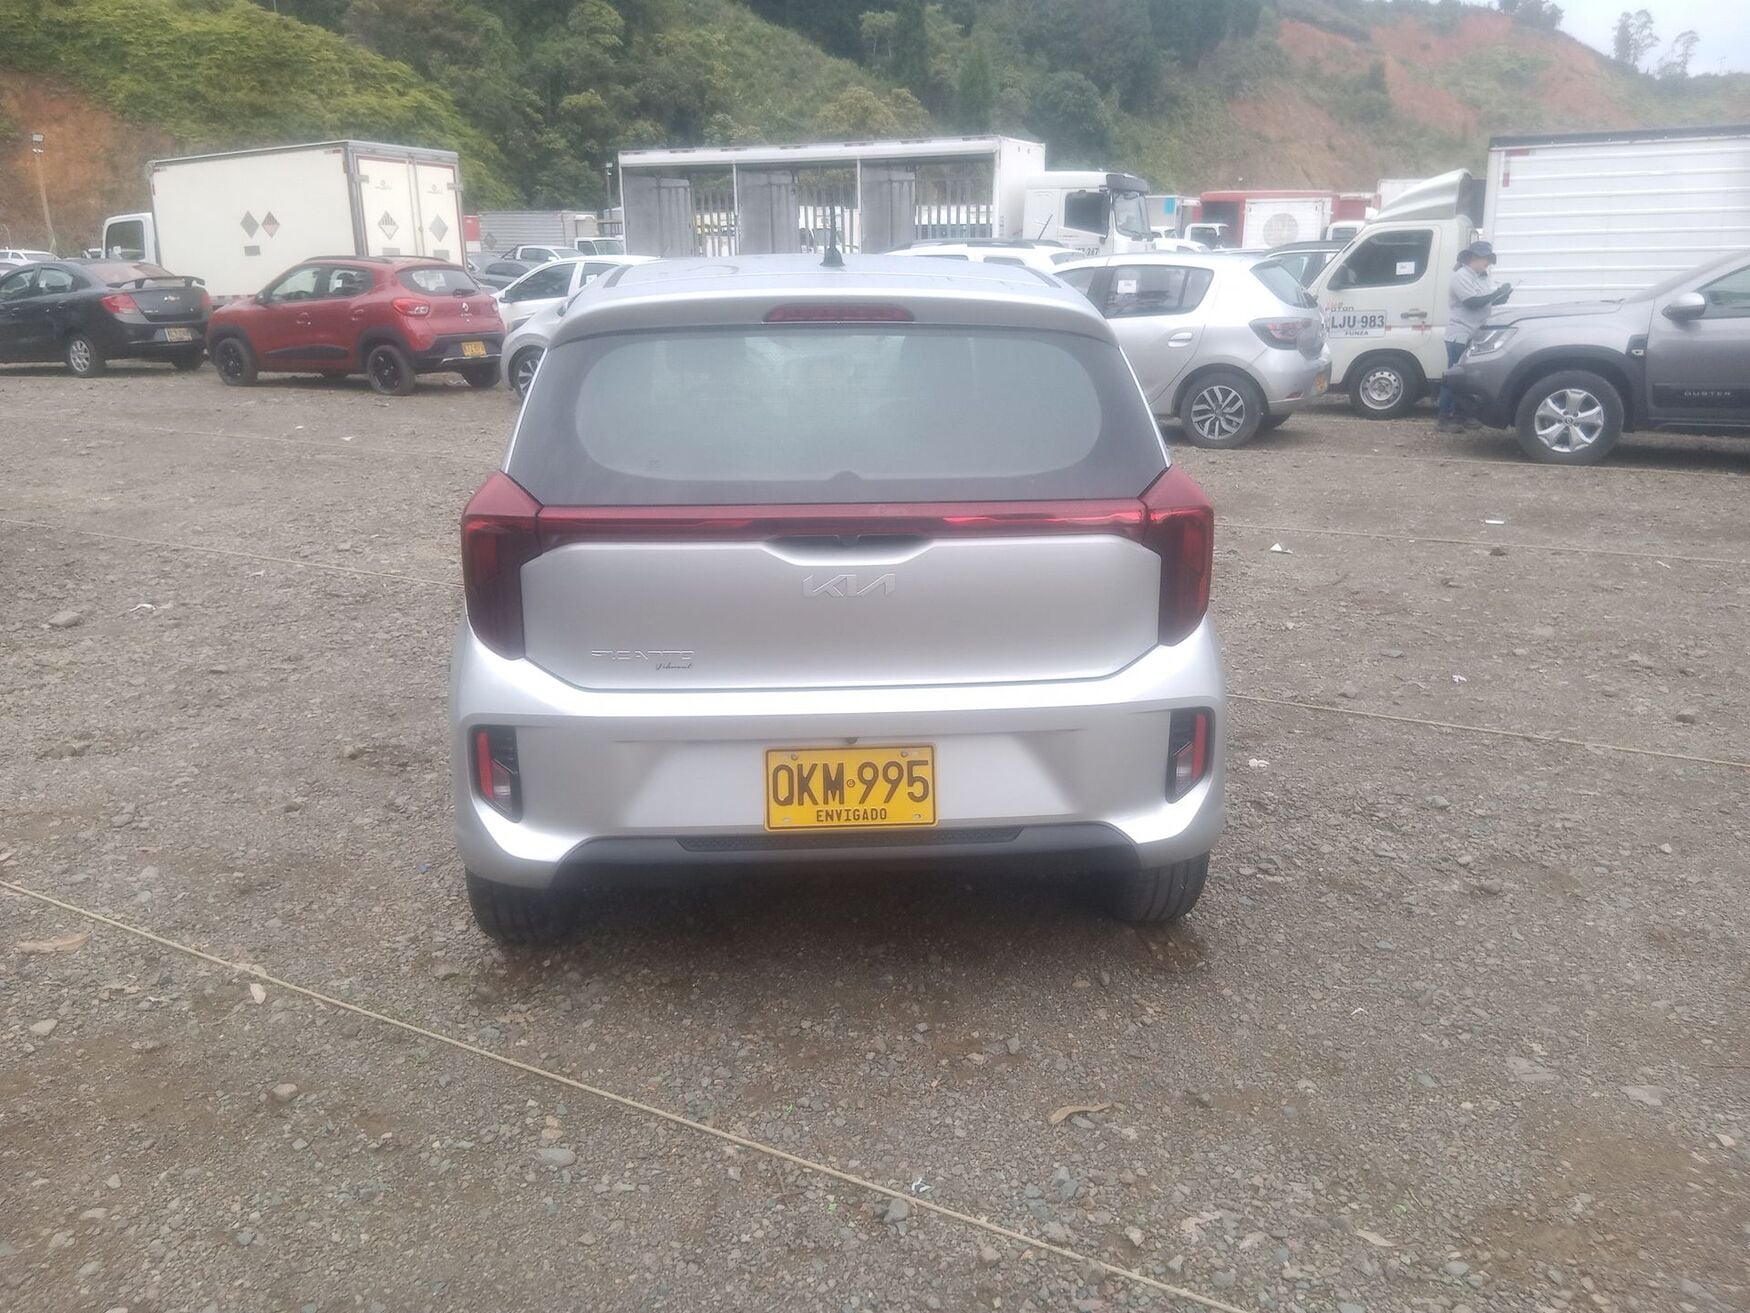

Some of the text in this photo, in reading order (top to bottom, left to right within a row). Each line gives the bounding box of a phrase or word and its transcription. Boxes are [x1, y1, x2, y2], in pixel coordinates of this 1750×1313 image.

[1331, 314, 1385, 329] LJU 983
[857, 760, 930, 805] 995
[816, 807, 888, 823] ENVIGADO
